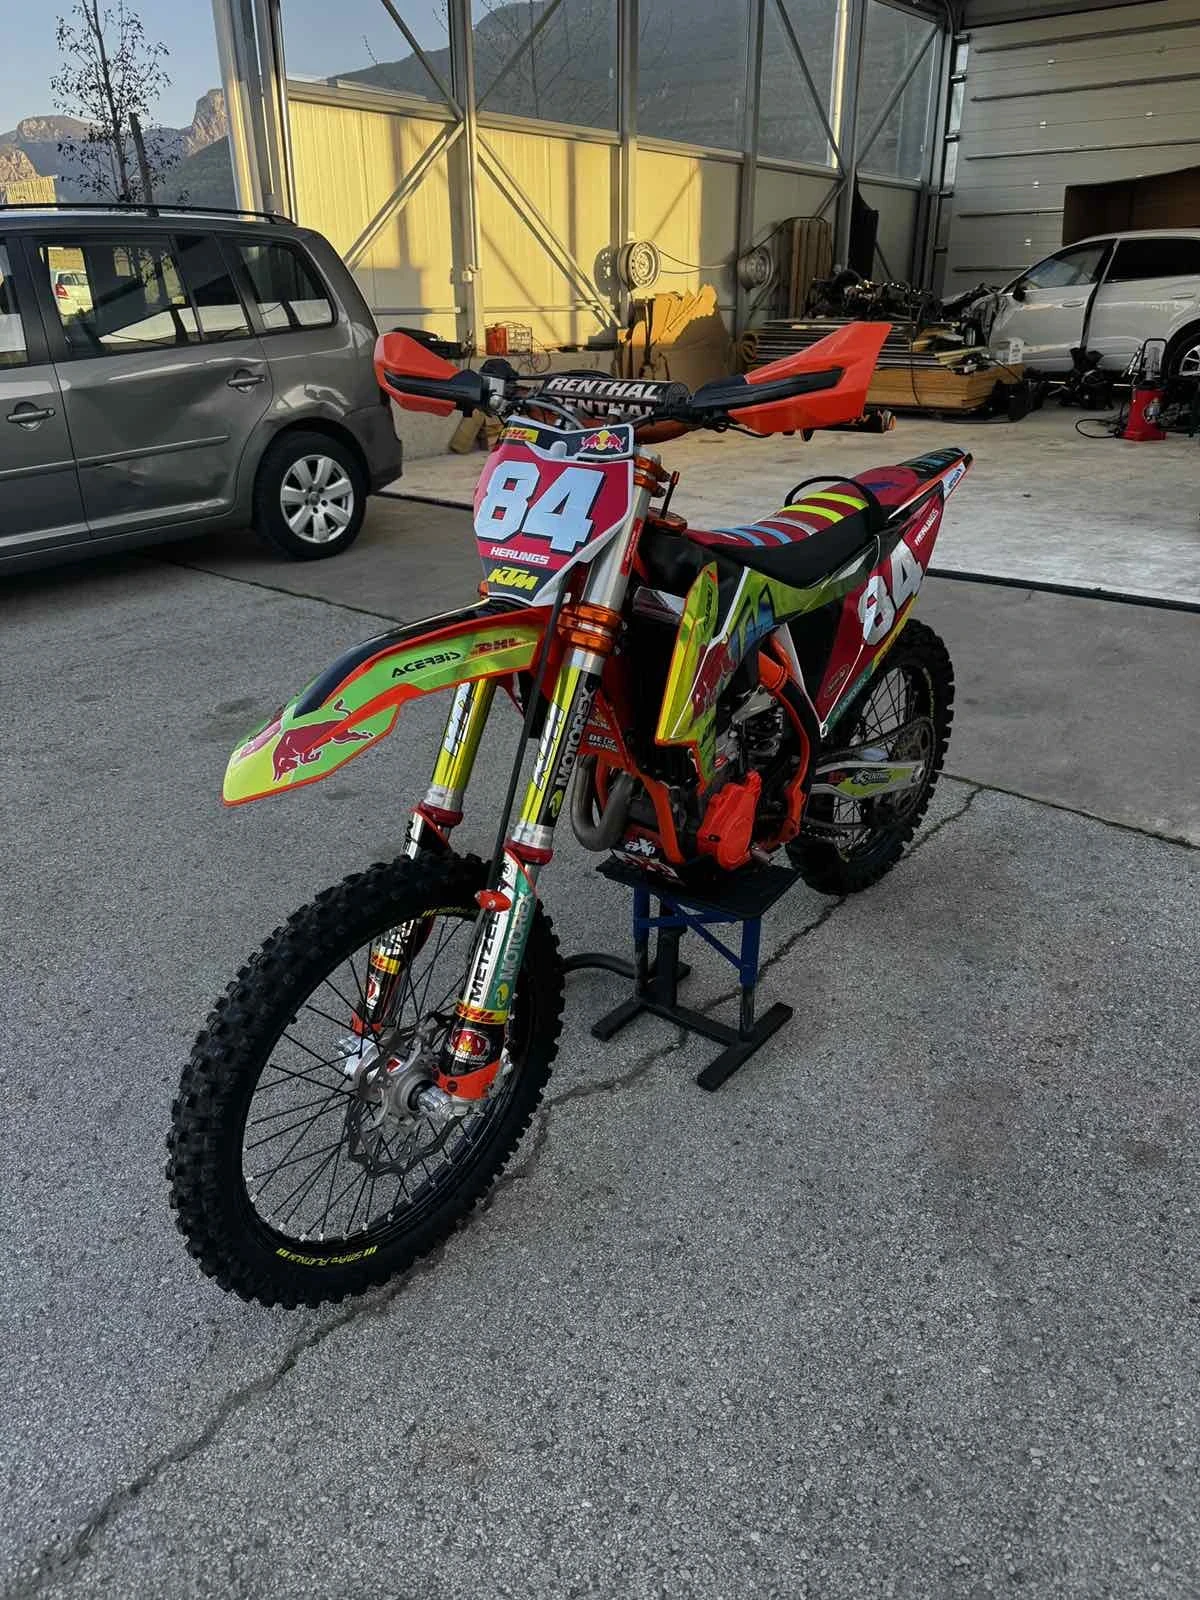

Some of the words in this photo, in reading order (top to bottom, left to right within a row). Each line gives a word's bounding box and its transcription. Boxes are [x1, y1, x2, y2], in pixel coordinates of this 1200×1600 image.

[547, 377, 659, 400] RENTHAL
[474, 461, 604, 552] 84
[487, 566, 539, 591] KTM
[490, 546, 550, 565] HERLINGS
[857, 539, 925, 646] 84
[391, 651, 462, 679] ACERBIS
[555, 687, 597, 786] MOTOREX
[469, 909, 501, 1003] METZEL
